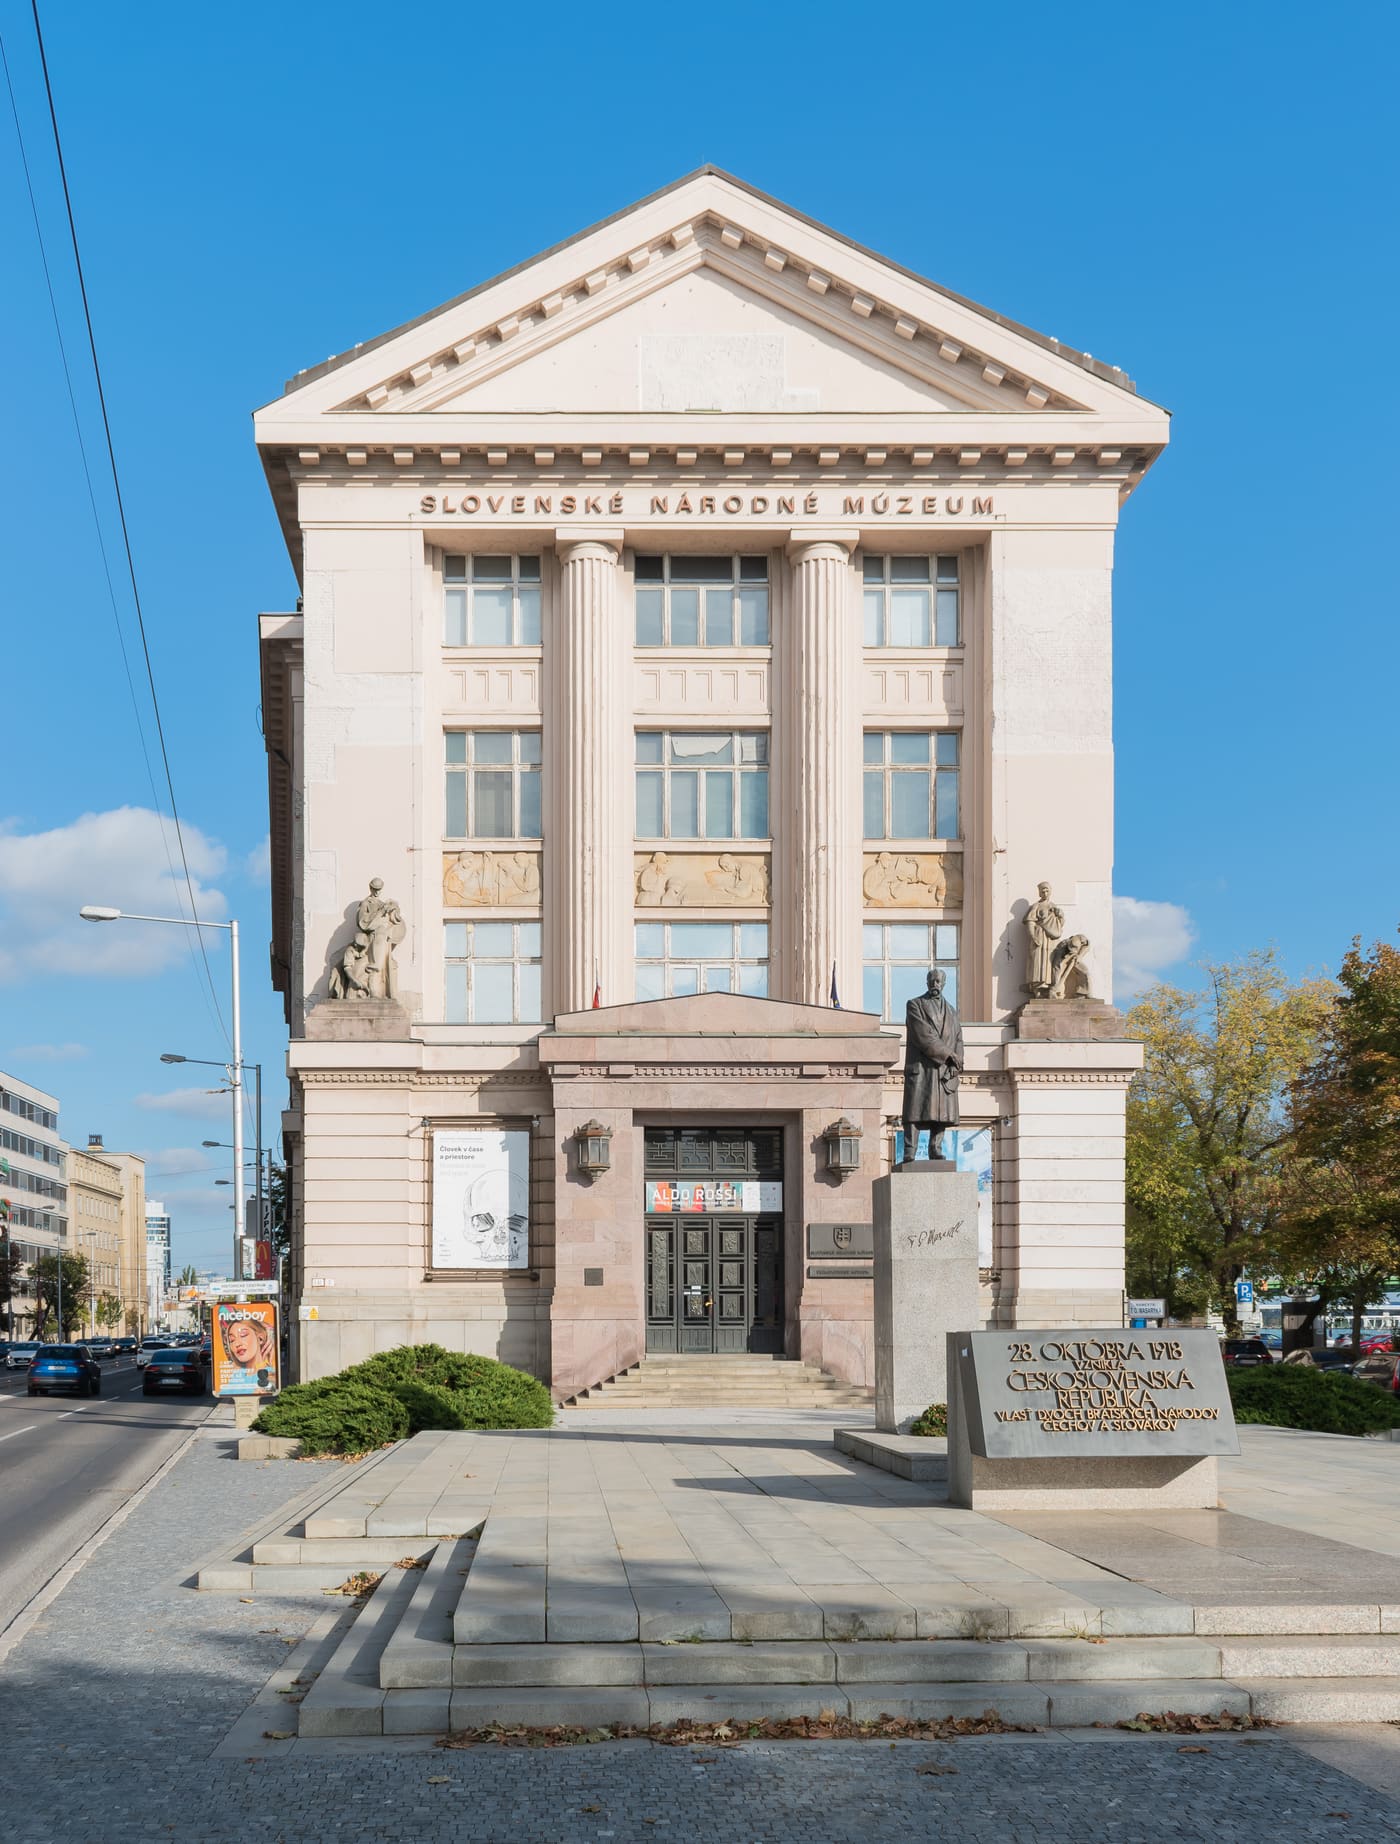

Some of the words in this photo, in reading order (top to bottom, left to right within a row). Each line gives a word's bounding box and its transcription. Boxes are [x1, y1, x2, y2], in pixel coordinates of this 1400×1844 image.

[420, 491, 624, 514] SLOVENSKÉ
[650, 491, 819, 514] NÁRODNÉ
[842, 491, 995, 514] MÚZEUM
[652, 1189, 690, 1200] ALDO
[695, 1189, 737, 1200] ROSSI
[218, 1308, 266, 1321] niceboy
[1007, 1343, 1038, 1362] 28.
[1040, 1339, 1145, 1361] OKTÓBRA
[1149, 1341, 1184, 1361] 1918
[1072, 1360, 1127, 1371] VZNIKLA
[1006, 1368, 1195, 1391] ČESKOSLOVENSKÁ
[1056, 1388, 1159, 1409] REPUBLIKA
[994, 1407, 1033, 1421] VLASŤ
[1036, 1408, 1083, 1421] DVOCH
[1086, 1406, 1153, 1420] BRATSKÝCH
[1155, 1406, 1221, 1420] NÁRODOV
[1040, 1418, 1095, 1432] ČECHOV
[1099, 1419, 1110, 1432] A
[1112, 1418, 1178, 1432] SLOVÁKOV
